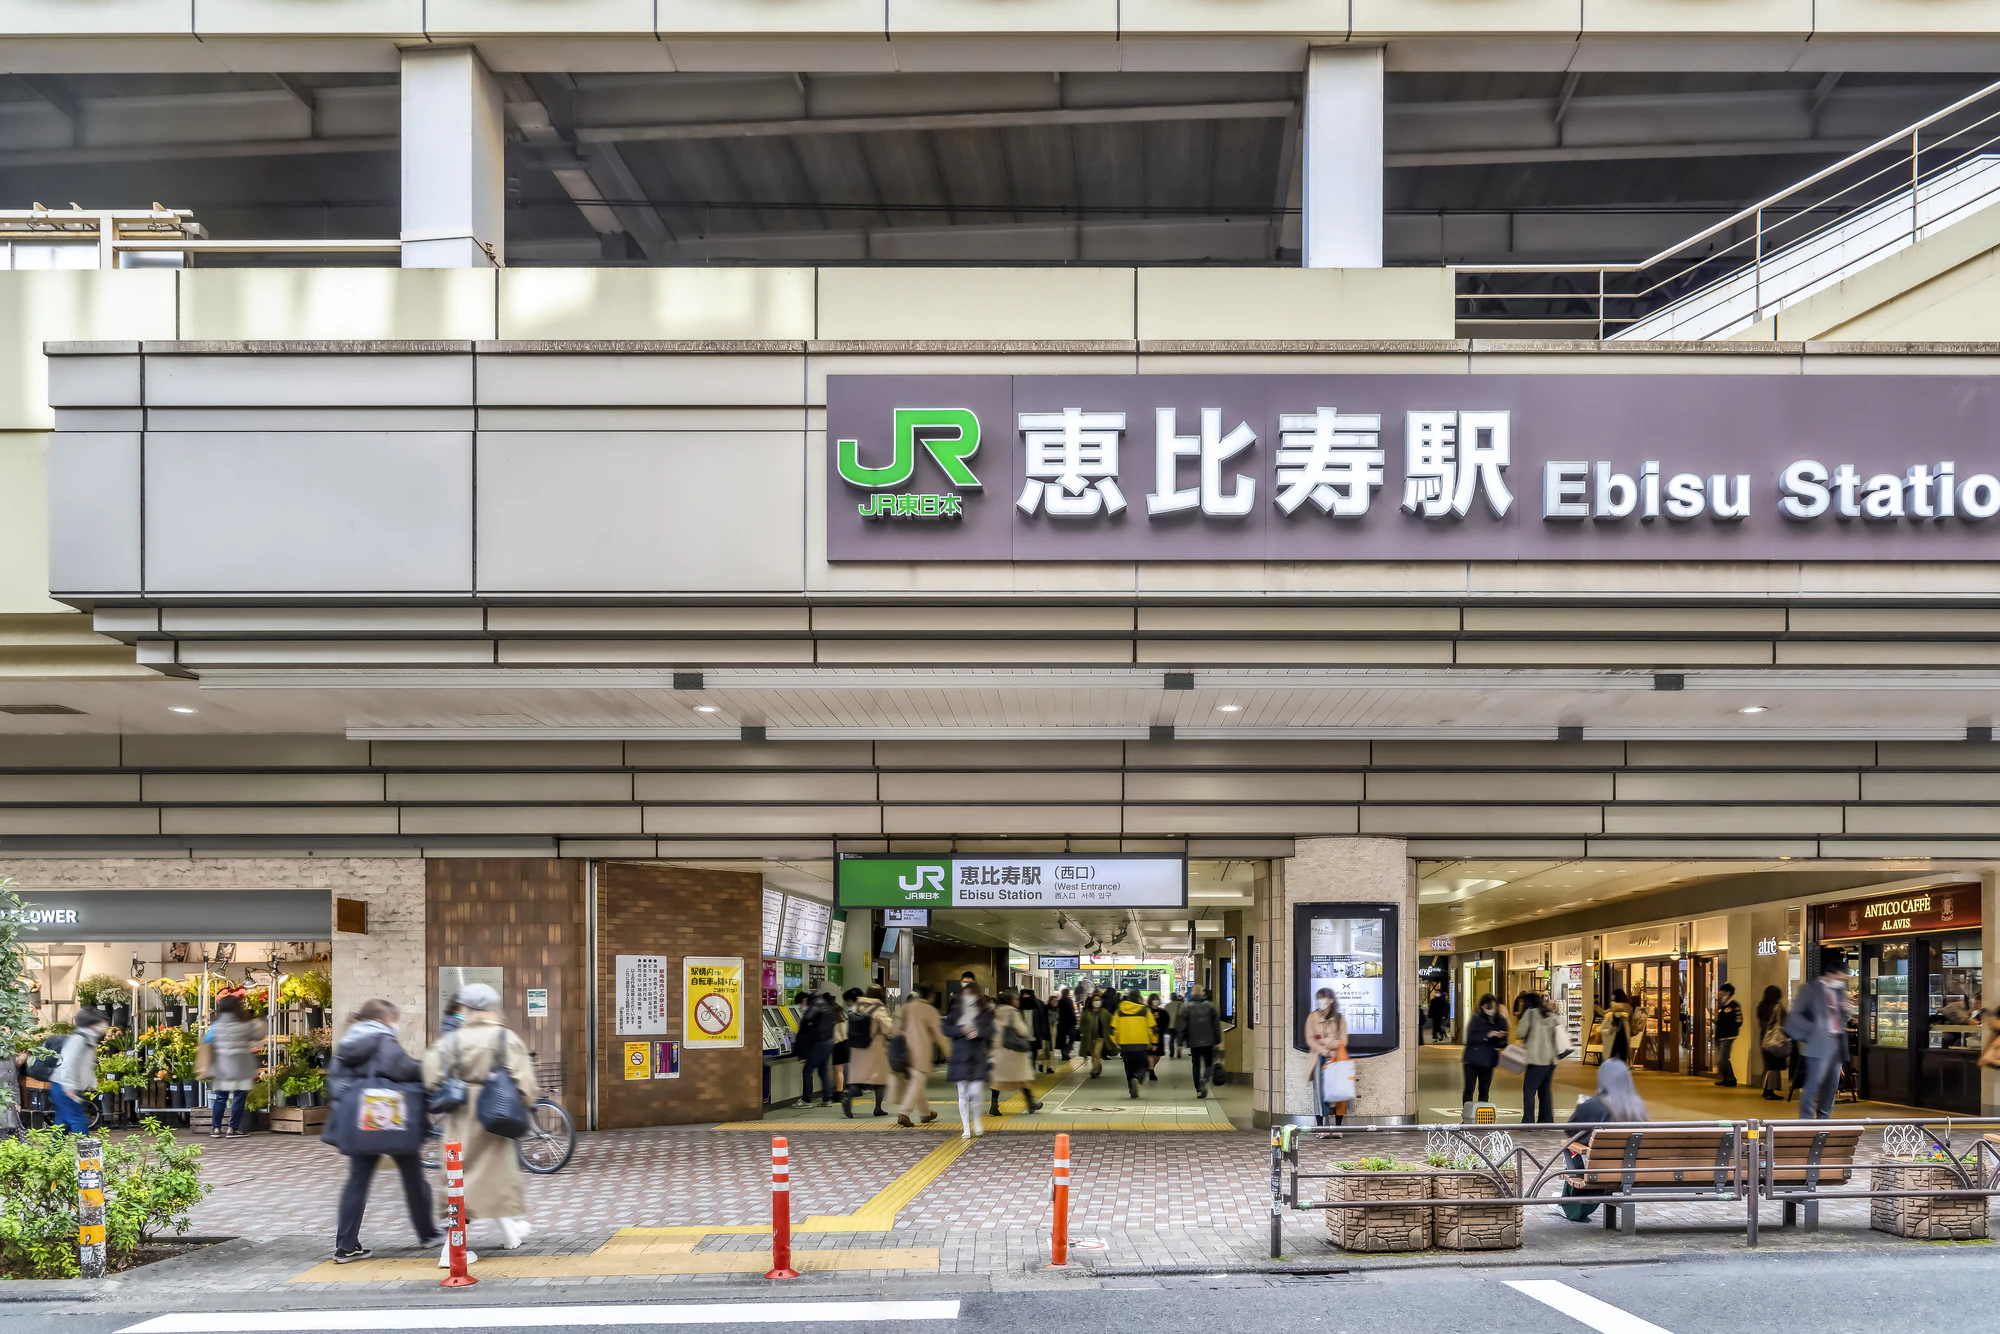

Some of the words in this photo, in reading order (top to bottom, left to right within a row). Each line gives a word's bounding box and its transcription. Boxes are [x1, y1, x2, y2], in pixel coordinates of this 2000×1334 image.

[837, 408, 983, 490] JR
[1016, 406, 1513, 518] 恵比寿駅
[1543, 460, 1751, 520] Ebisu
[858, 493, 962, 518] JR東日本
[899, 865, 945, 891] JR
[960, 866, 1042, 886] 恵比寿駅
[904, 892, 940, 900] JR東日本
[959, 889, 995, 900] Ebisu
[998, 889, 1043, 900] Station
[1054, 882, 1079, 891] (West
[1081, 882, 1121, 891] Entrance)
[1864, 899, 1902, 918] ANTICO
[1900, 893, 1931, 914] CAFFÈ
[1881, 919, 1893, 931] AL
[1893, 918, 1911, 930] AVIS
[1431, 938, 1451, 949] atré
[1758, 936, 1778, 954] atré
